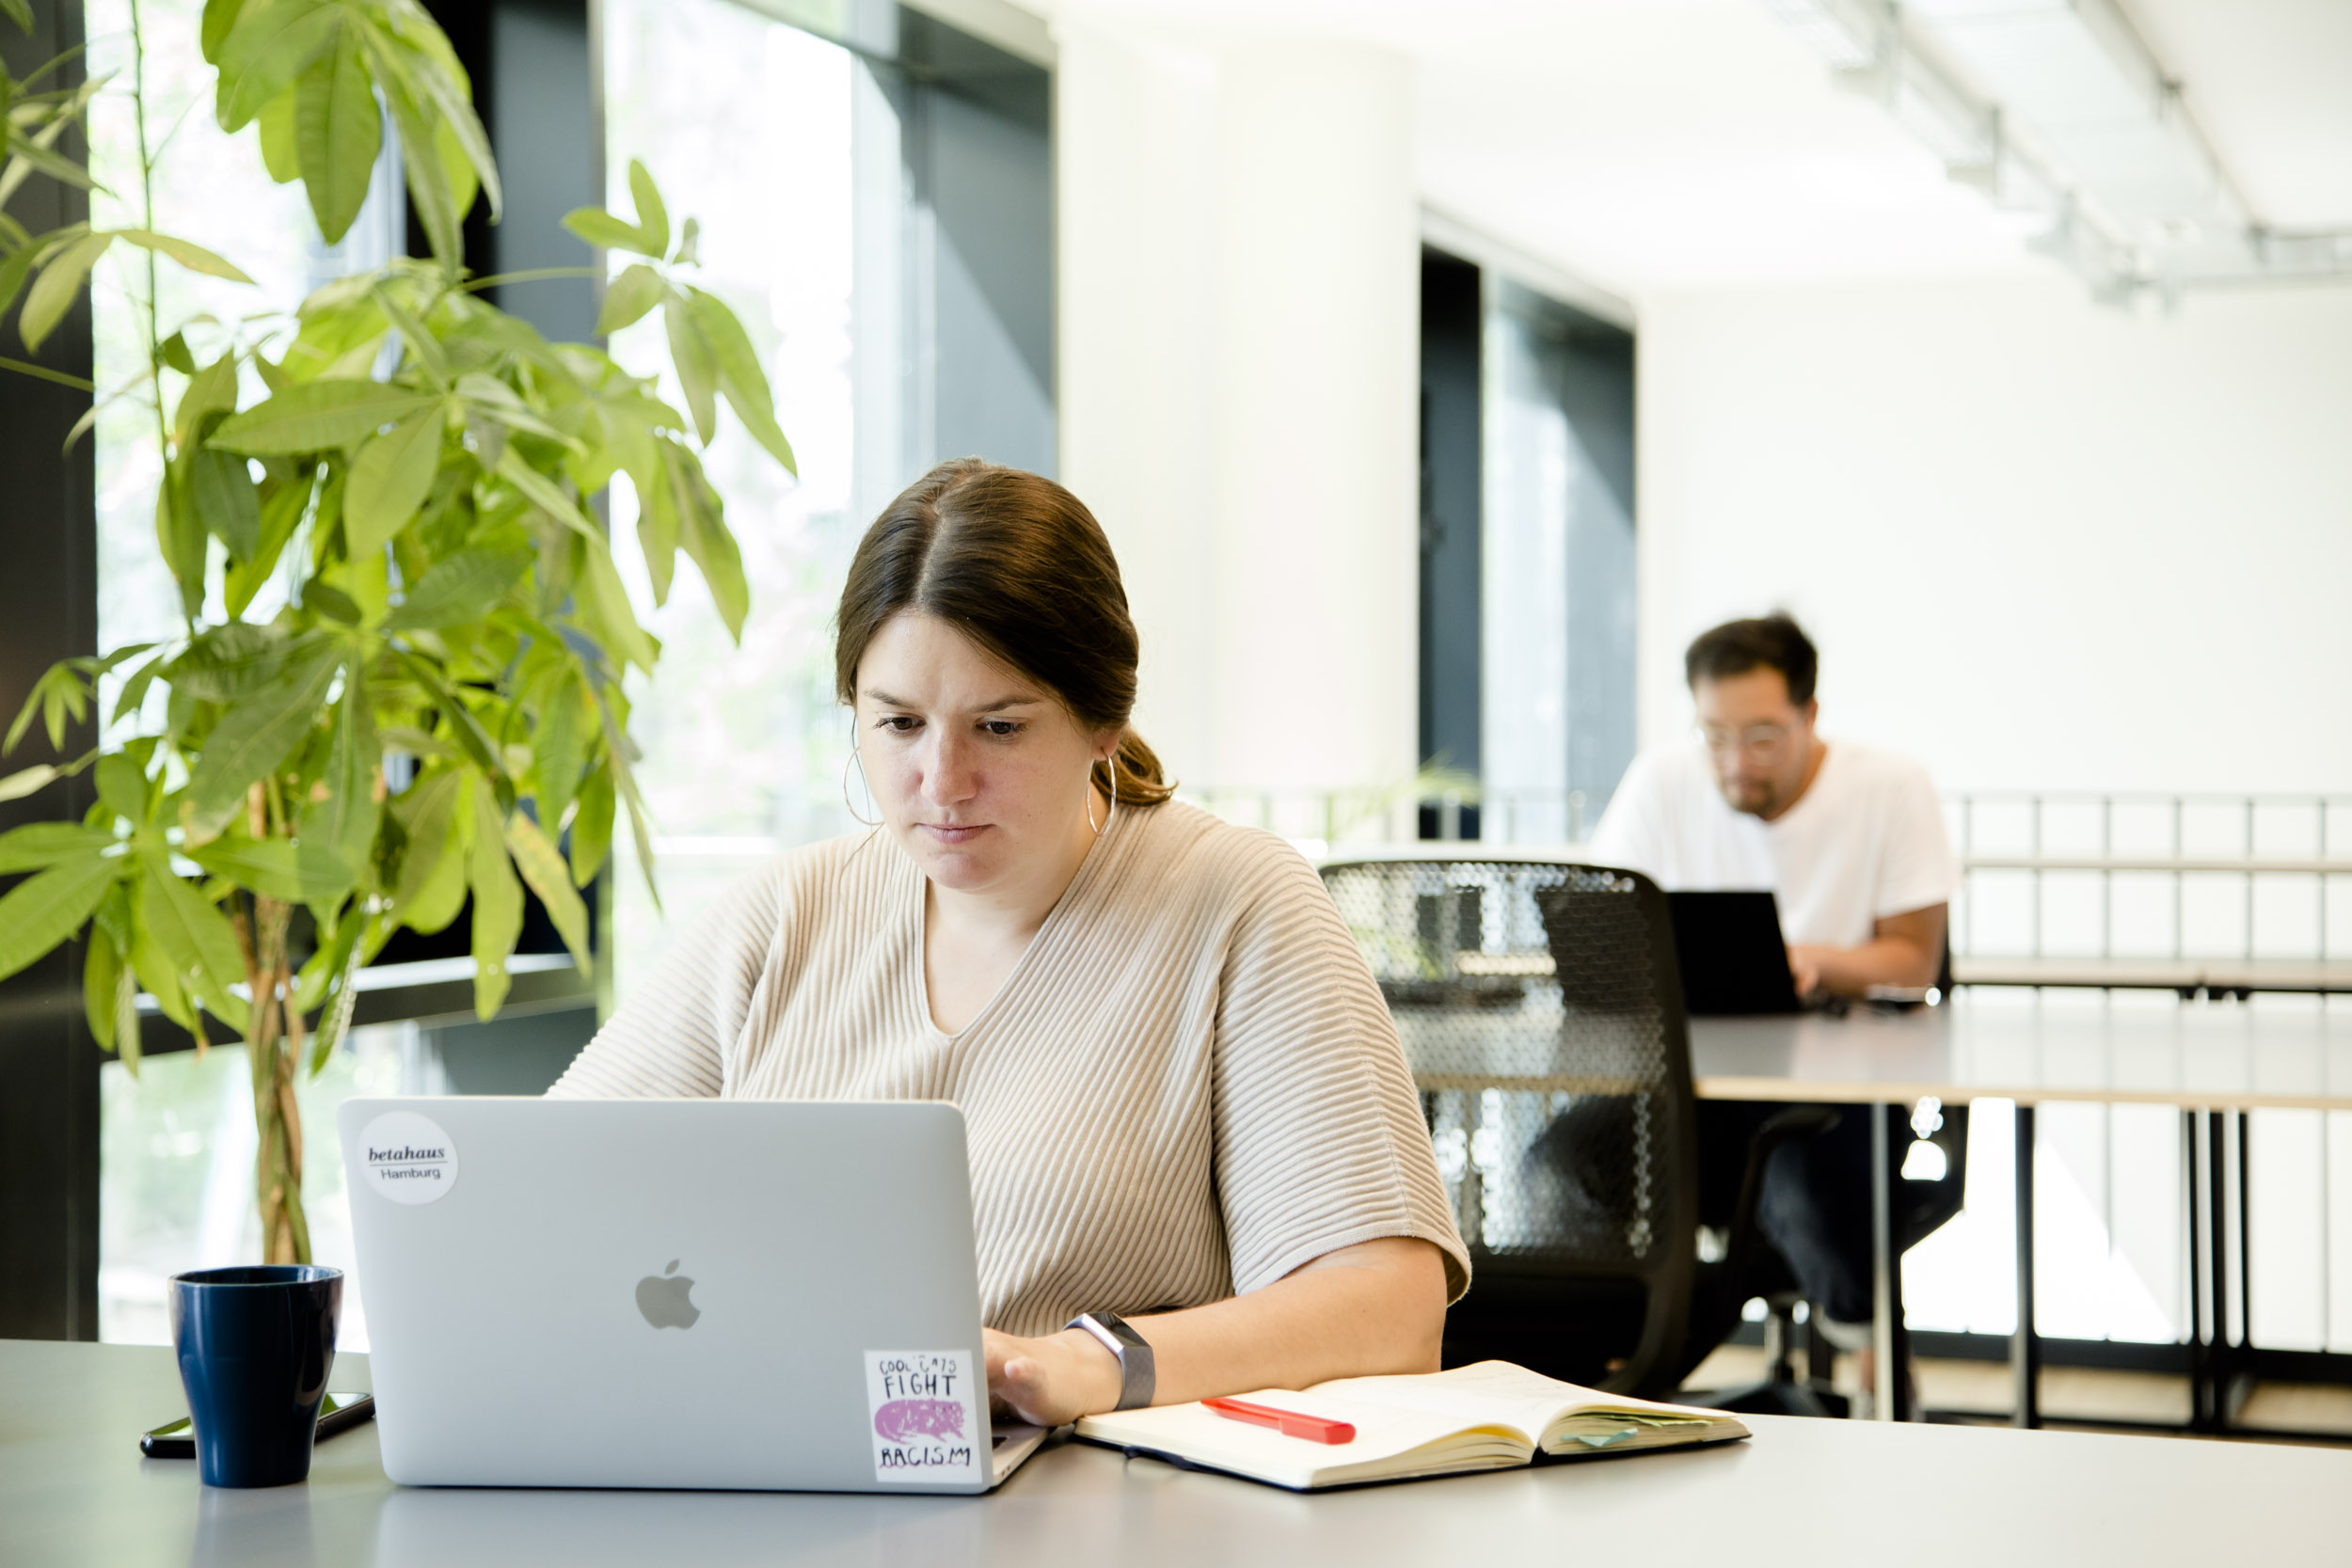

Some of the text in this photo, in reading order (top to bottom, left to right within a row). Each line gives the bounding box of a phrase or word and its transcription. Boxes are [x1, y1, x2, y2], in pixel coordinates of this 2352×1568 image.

[369, 1146, 445, 1162] betahaus
[380, 1167, 441, 1180] Hamburg
[883, 1372, 957, 1400] FIGHT
[881, 1447, 971, 1467] RACISM
